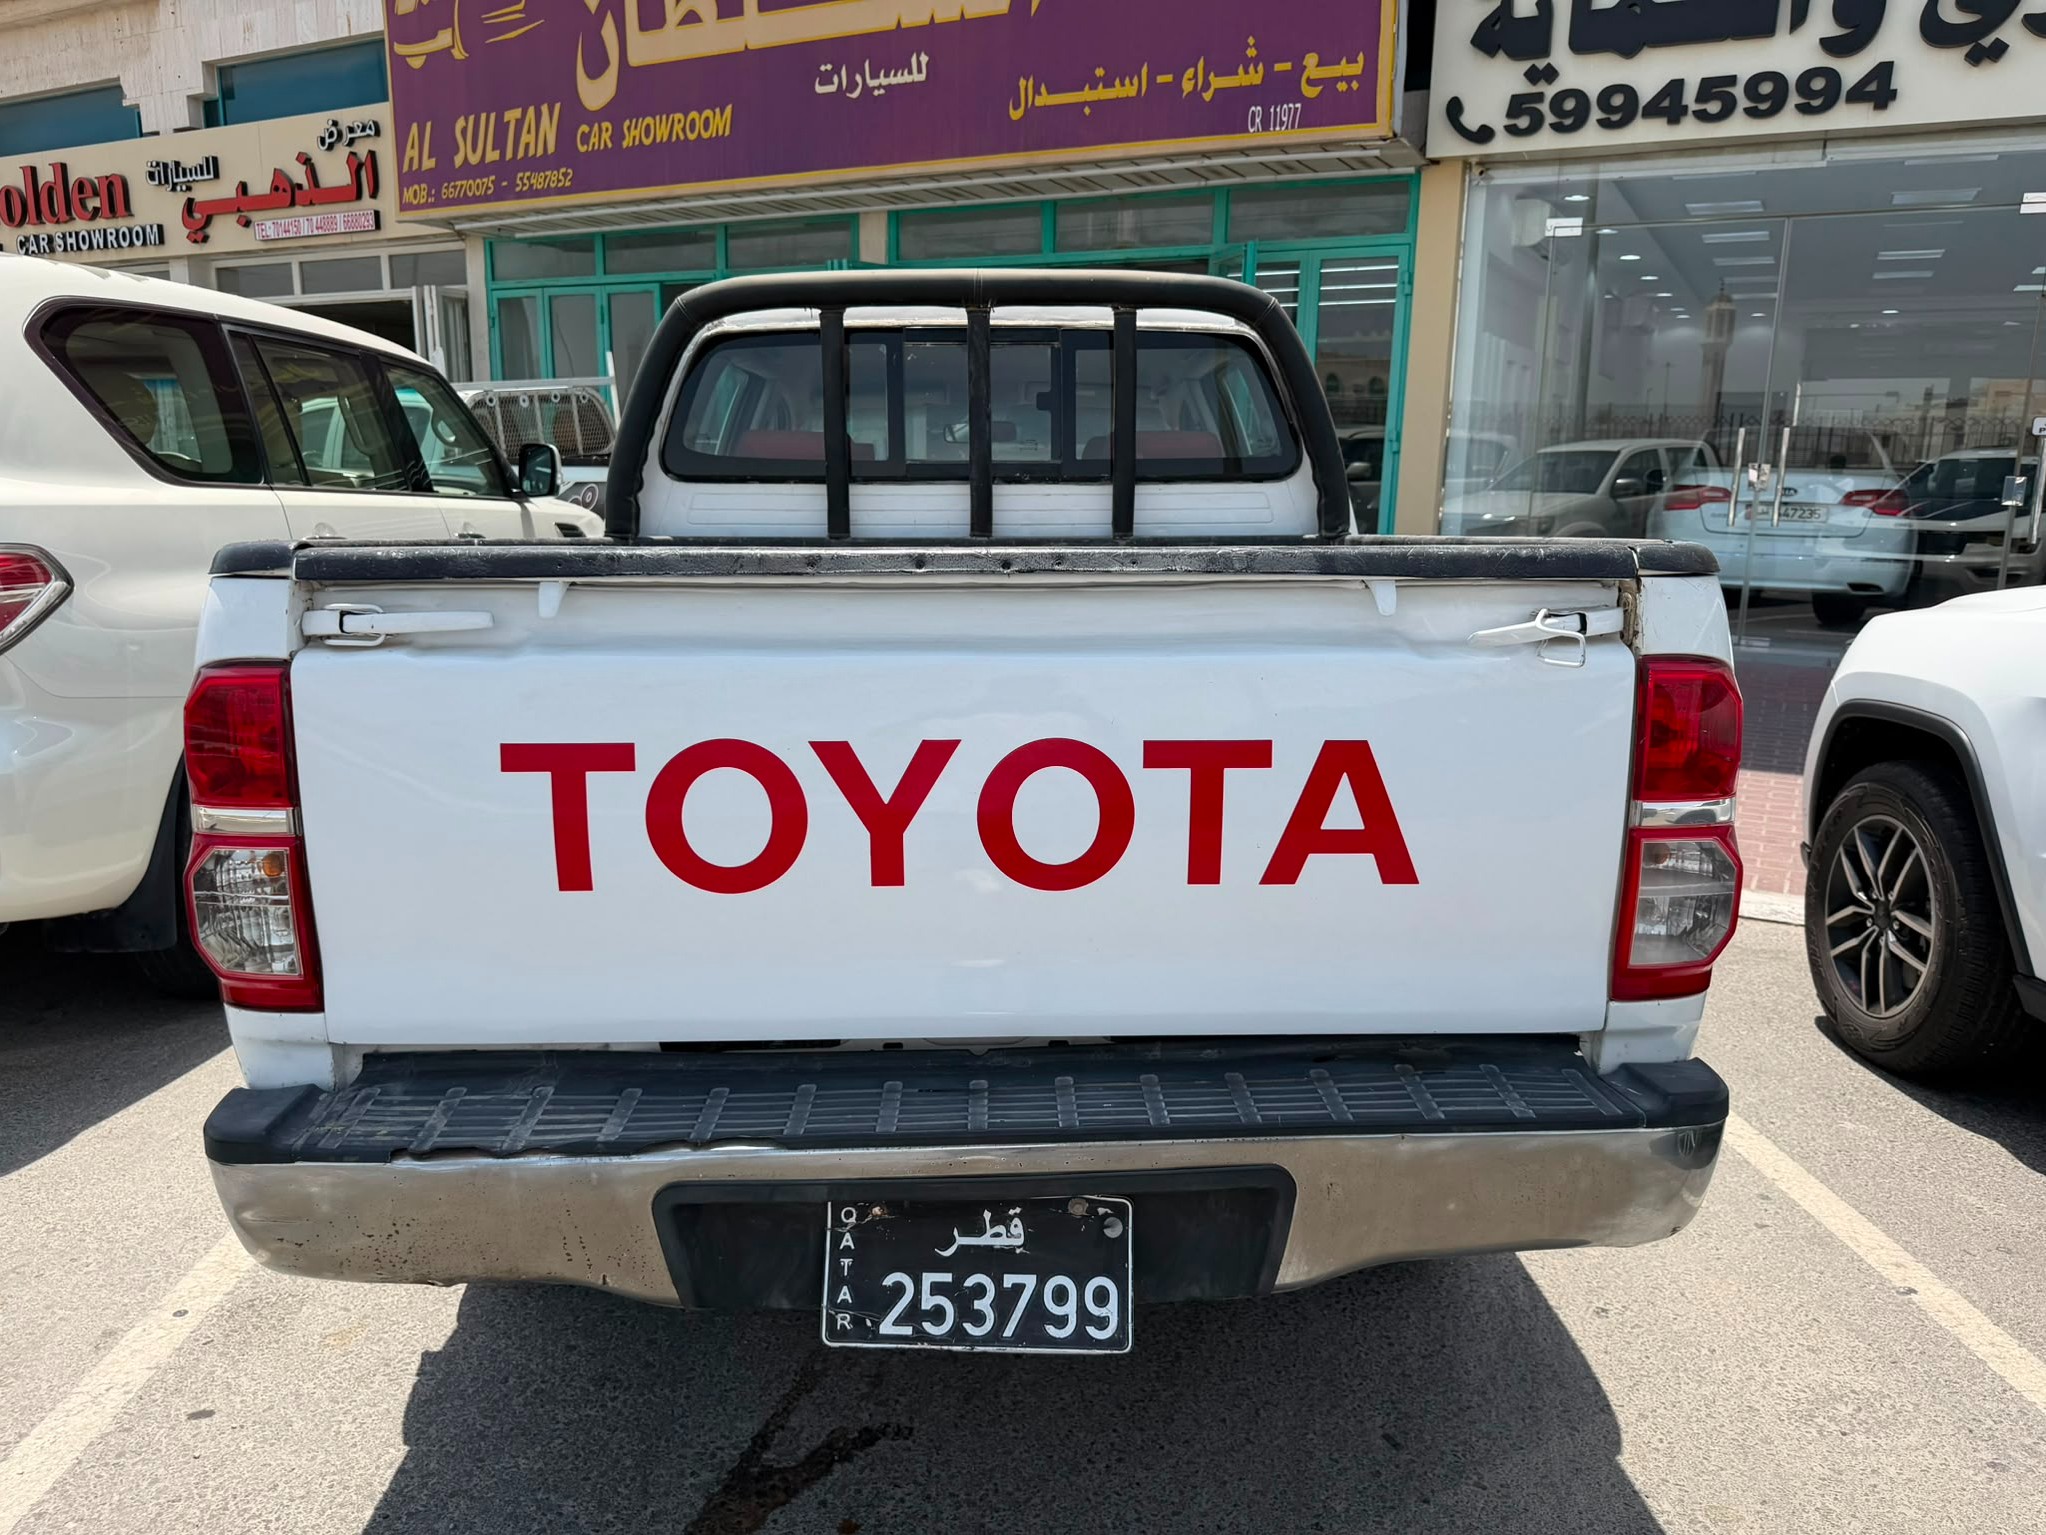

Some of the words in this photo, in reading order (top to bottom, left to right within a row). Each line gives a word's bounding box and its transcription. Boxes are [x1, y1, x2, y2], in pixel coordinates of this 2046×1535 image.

[814, 50, 929, 99] للسيارات
[1009, 61, 1148, 121] استبدال
[1181, 35, 1264, 102] شراء
[1300, 50, 1364, 99] بيع
[1247, 106, 1262, 132] CR
[1269, 103, 1301, 131] 11977
[1503, 61, 1898, 137] 59945994
[316, 119, 379, 151] معرض
[402, 121, 436, 174] AL
[453, 102, 561, 169] SULTAN
[576, 121, 613, 153] CAR
[622, 103, 733, 149] SHOWROOM
[0, 161, 133, 228] olden
[145, 156, 219, 192] للسيارات
[181, 149, 379, 243] الذهبي
[441, 175, 495, 199] 66770075
[515, 167, 573, 192] 55487852
[16, 233, 52, 256] CAR
[54, 223, 163, 252] SHOWROOM
[500, 736, 1420, 895] TOYOTA
[934, 1205, 1026, 1257] قطر
[836, 1206, 857, 1332] QATAR
[878, 1271, 1120, 1341] 253799
